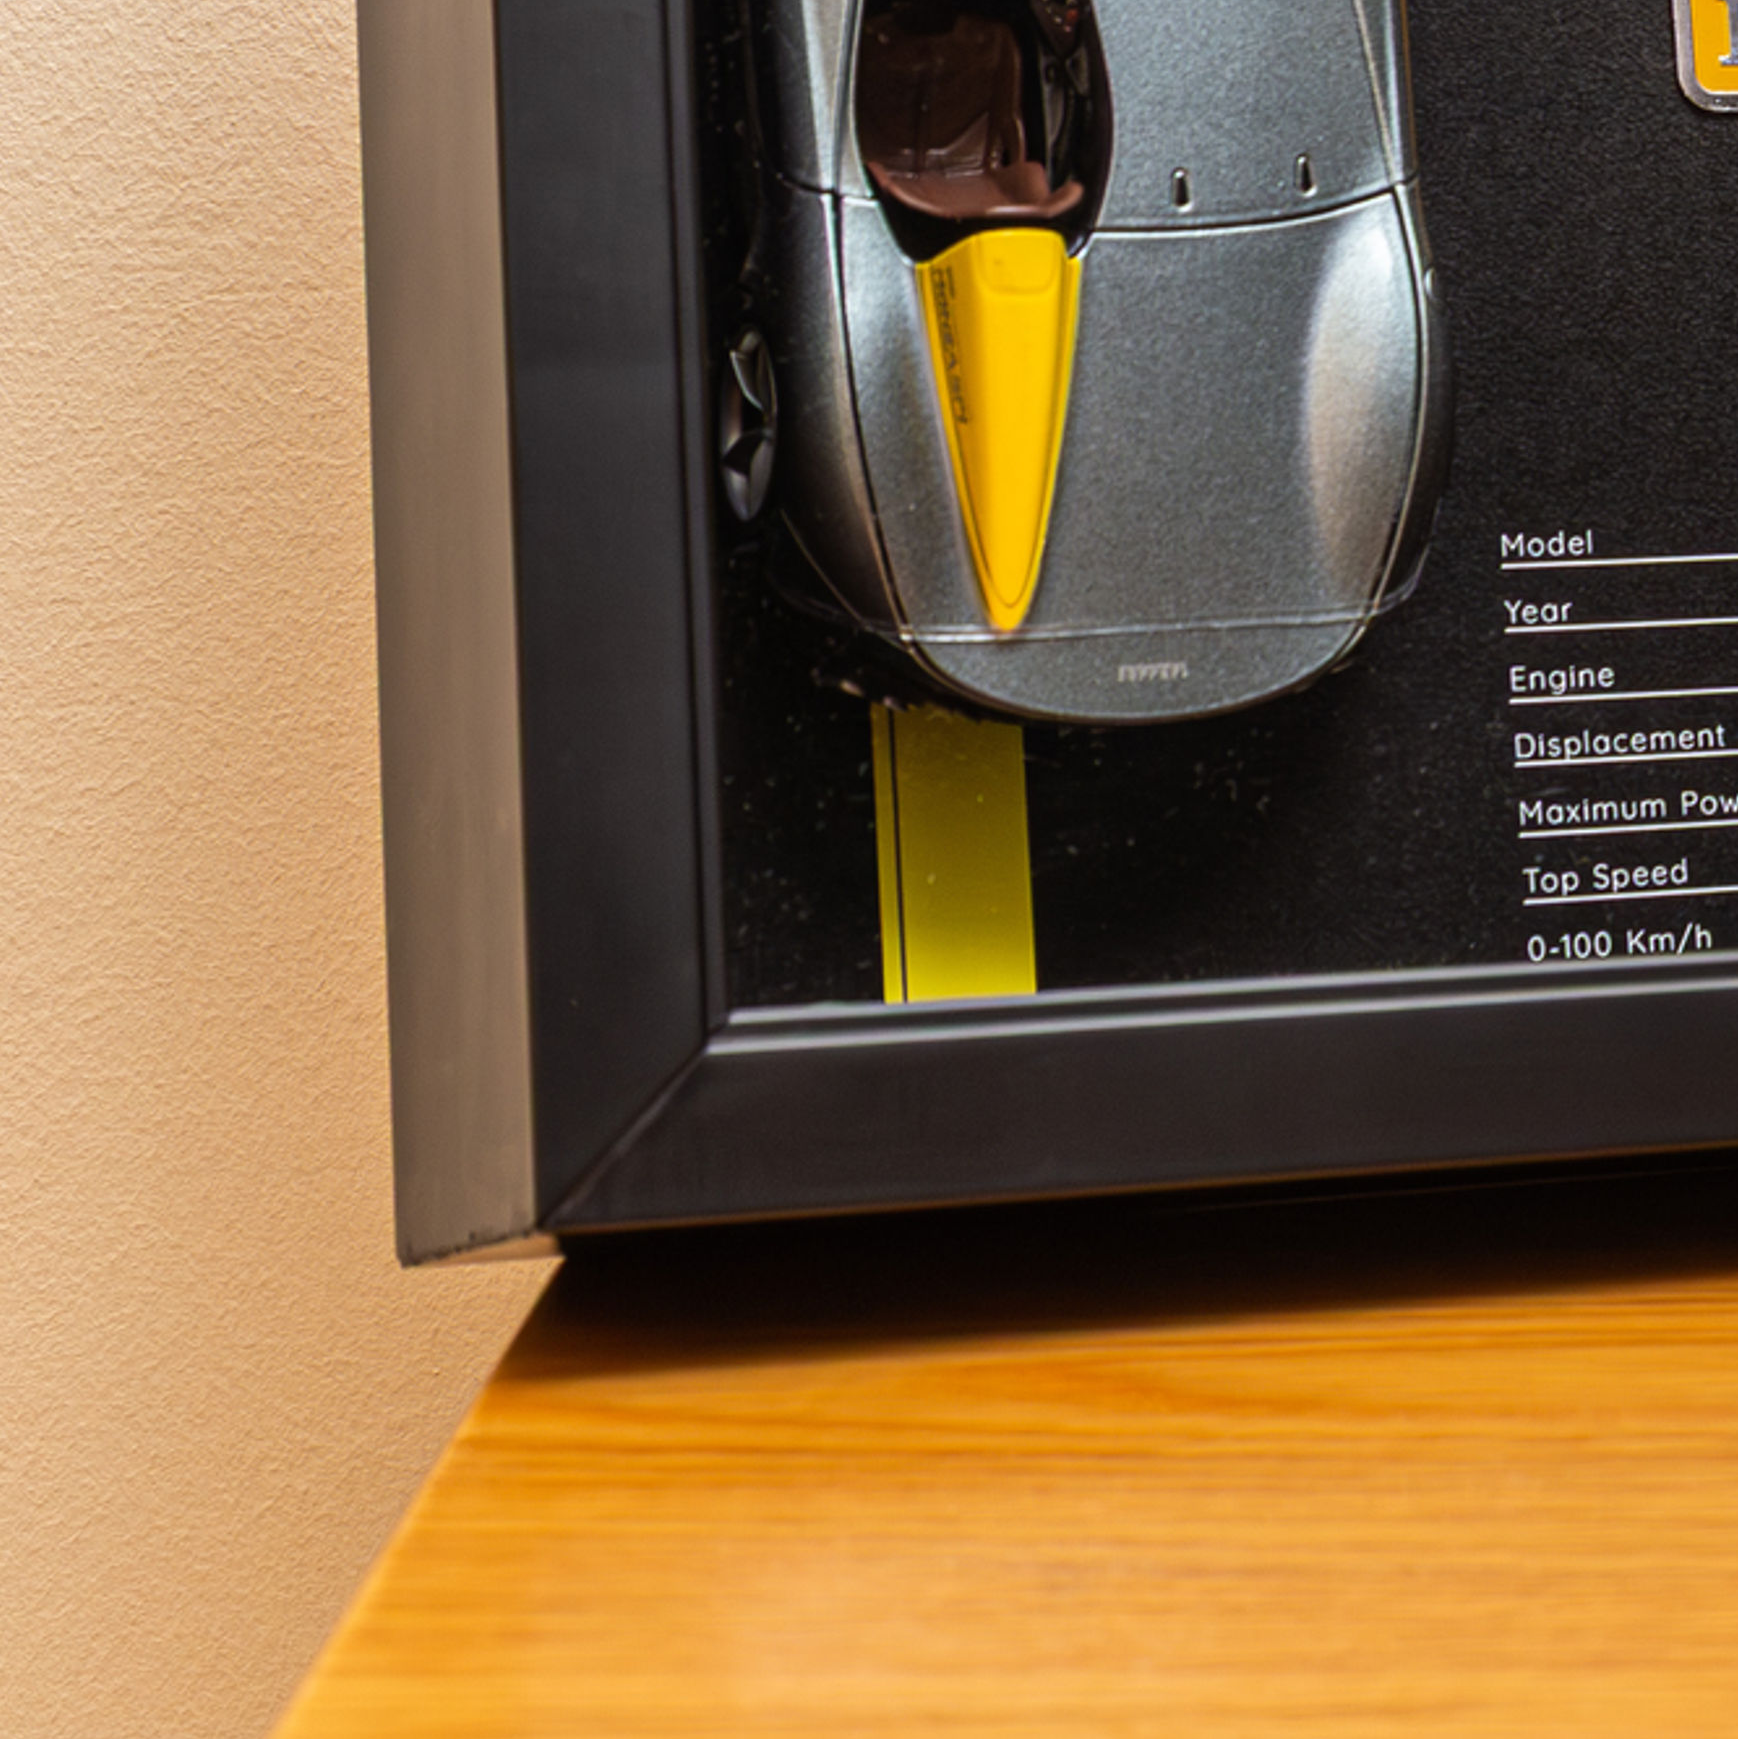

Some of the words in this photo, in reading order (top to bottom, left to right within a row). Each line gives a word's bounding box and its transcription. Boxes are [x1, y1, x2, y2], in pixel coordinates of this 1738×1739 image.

[1500, 529, 1593, 558] Model
[1503, 599, 1572, 625] Year
[1509, 665, 1615, 696] Engine
[1514, 724, 1726, 761] Displacement
[1519, 798, 1667, 827] Maximum
[1522, 867, 1580, 896] Top
[1592, 858, 1688, 893] Speed
[1527, 930, 1613, 962] 0-100
[1626, 922, 1712, 955] Km/h
